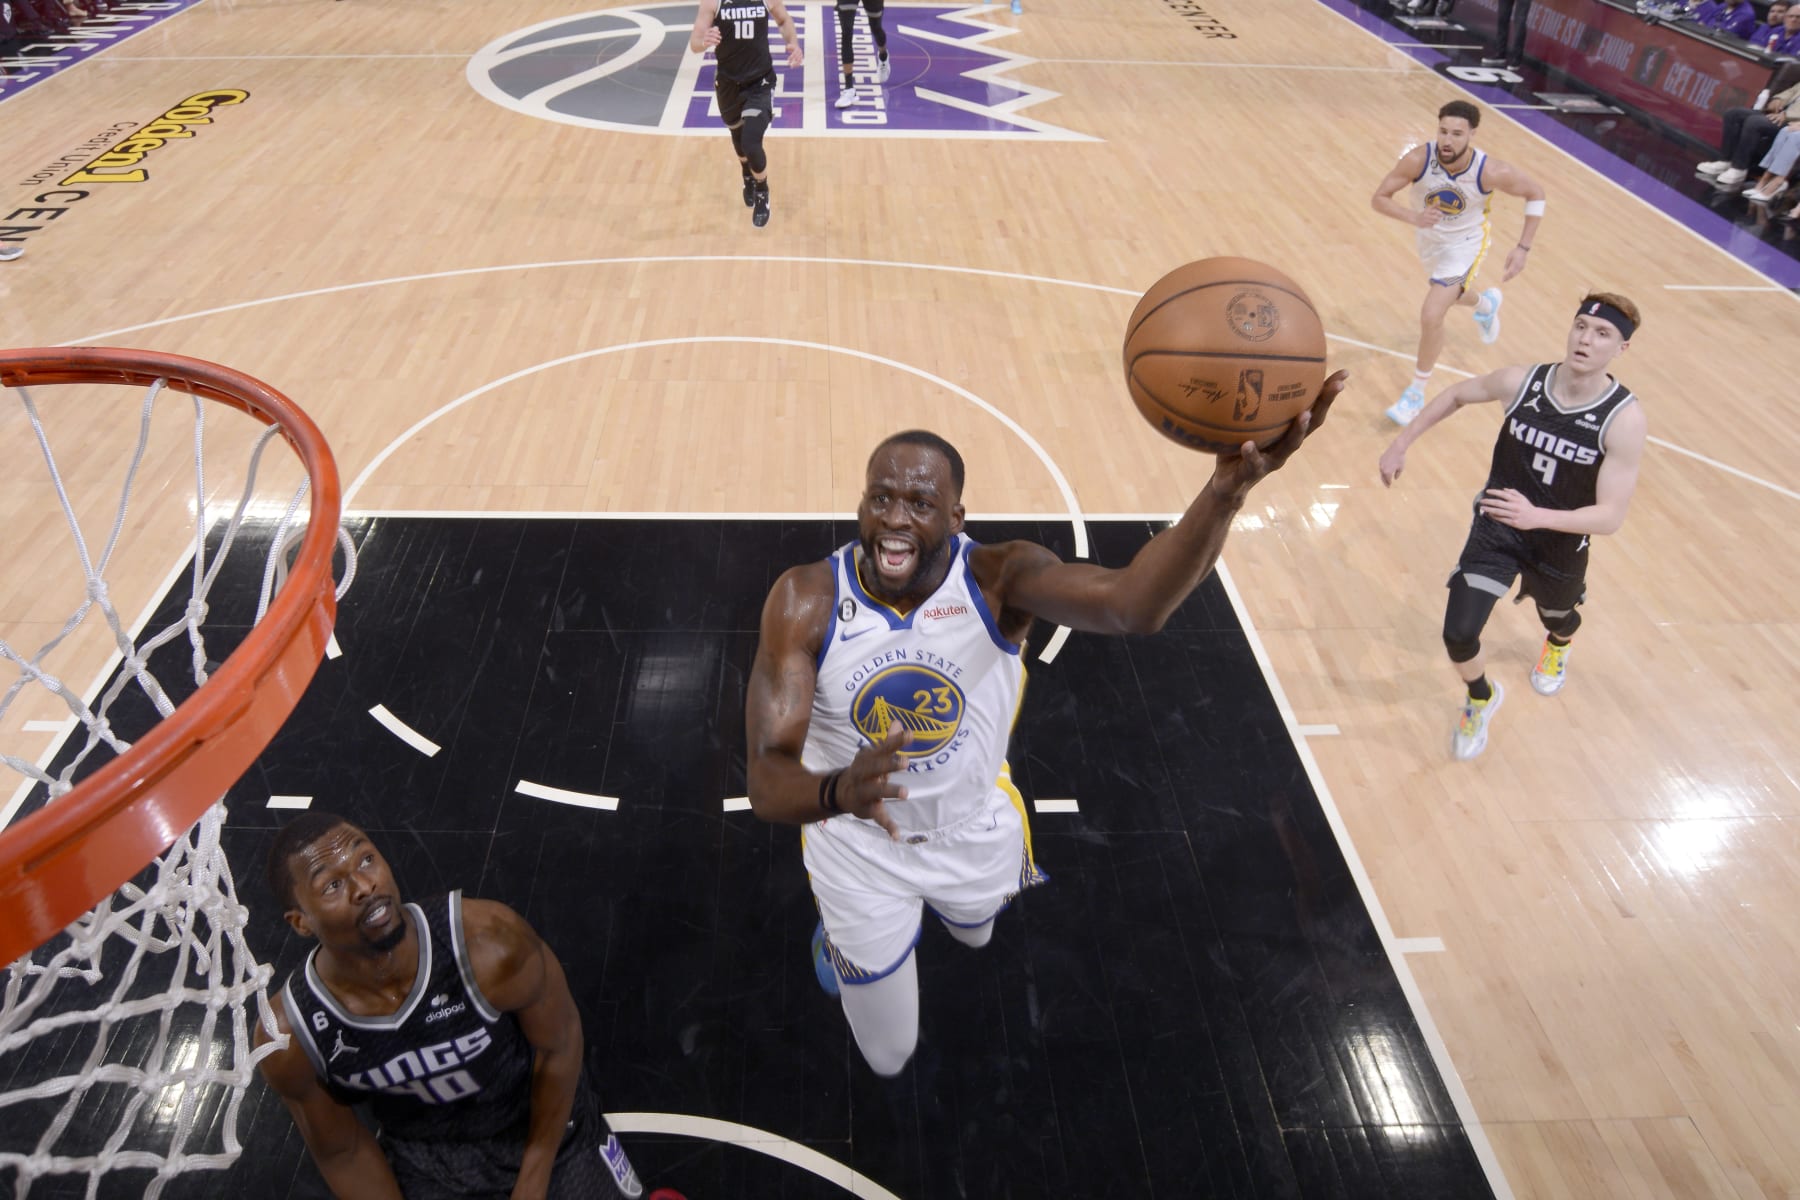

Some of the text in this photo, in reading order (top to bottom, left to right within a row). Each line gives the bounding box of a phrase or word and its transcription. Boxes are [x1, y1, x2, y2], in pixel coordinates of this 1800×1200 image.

[720, 6, 766, 20] KINGS
[734, 20, 754, 39] 10
[1163, 0, 1238, 39] ENTER
[0, 1, 182, 94] RAMENT
[1663, 60, 1693, 97] GET
[1687, 71, 1722, 110] THE
[86, 88, 251, 168] Golden
[20, 121, 139, 186] Credit Union
[0, 190, 90, 242] CEN
[1509, 417, 1599, 466] KINGS
[1574, 418, 1600, 432] dialpad
[1532, 452, 1557, 485] 9
[923, 605, 968, 620] Rakuten
[845, 648, 963, 692] GOLDEN STATE
[913, 687, 952, 713] 23
[312, 1010, 329, 1031] 6
[425, 1001, 466, 1023] dialpad
[332, 1027, 492, 1090] KINGS
